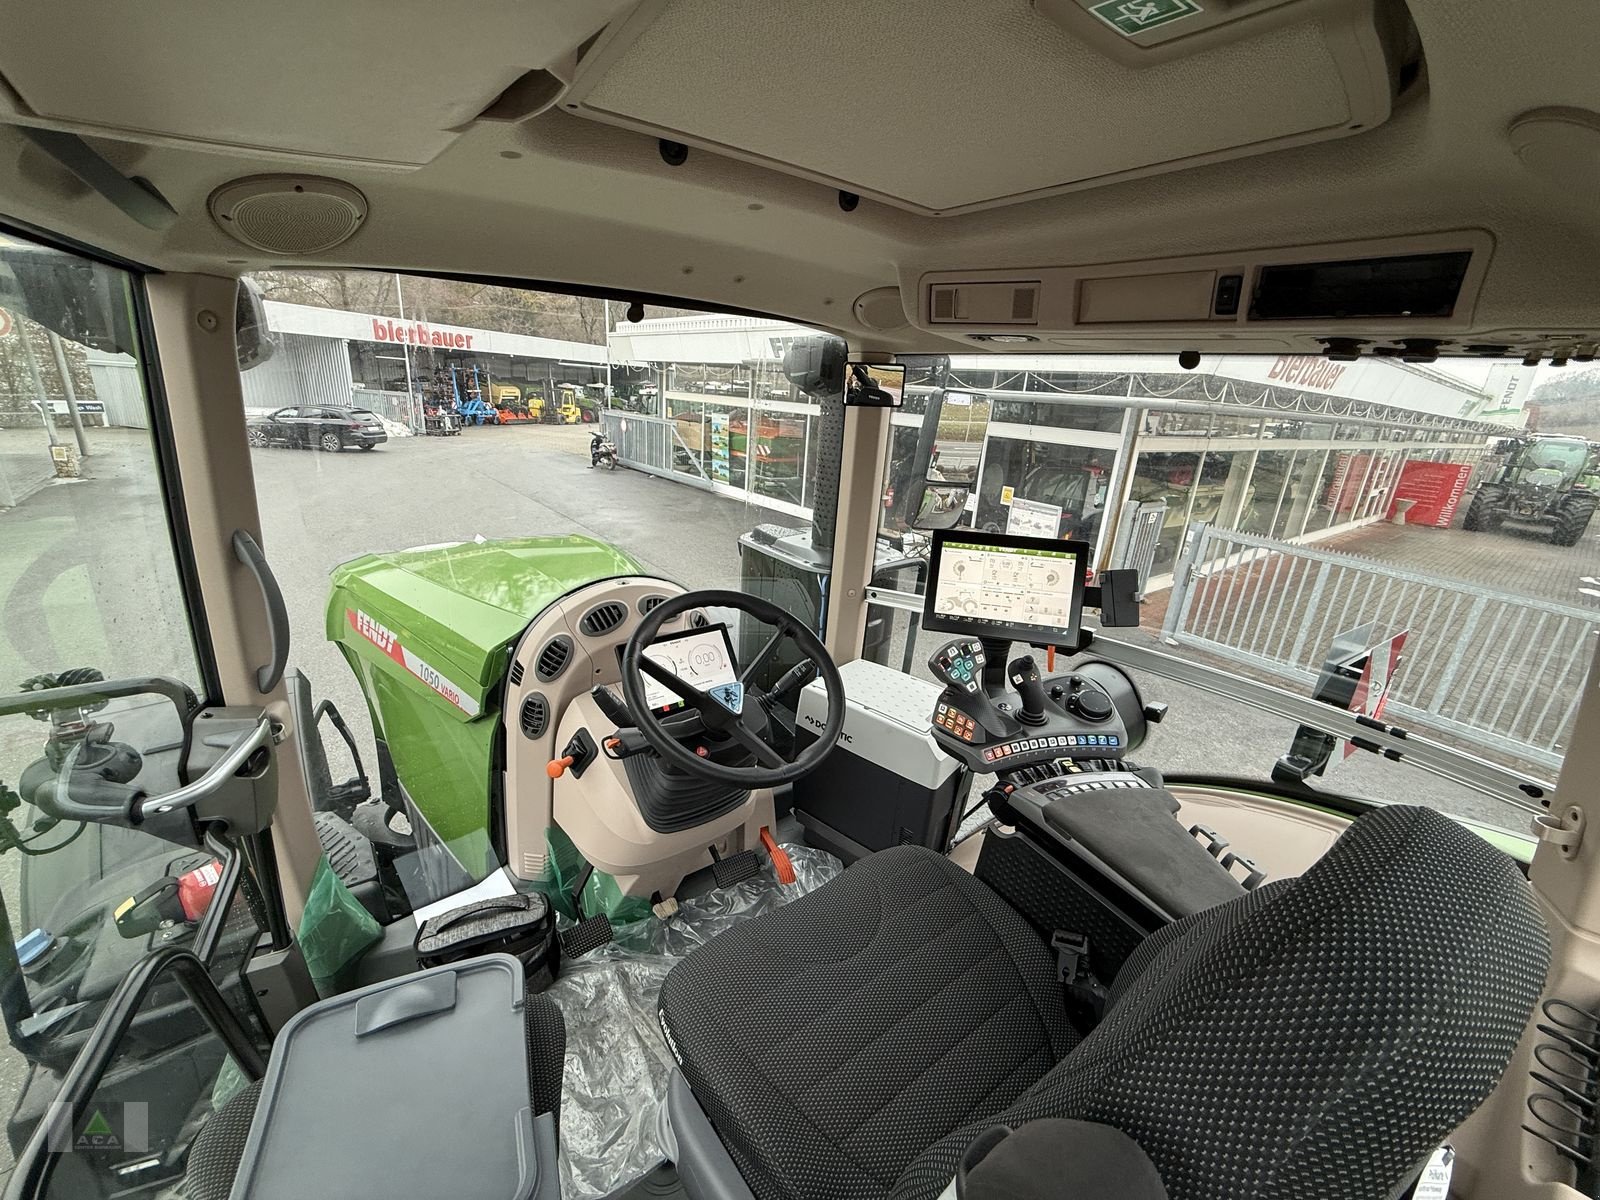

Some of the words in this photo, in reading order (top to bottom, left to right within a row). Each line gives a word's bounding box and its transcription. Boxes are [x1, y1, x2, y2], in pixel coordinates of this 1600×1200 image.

[372, 319, 474, 349] bierbauer
[1499, 375, 1520, 411] FENDT
[1436, 465, 1470, 527] Willkommen
[357, 608, 398, 654] FENDT
[419, 663, 440, 689] 1050
[440, 682, 461, 705] VARIO
[815, 720, 853, 743] DOTIC
